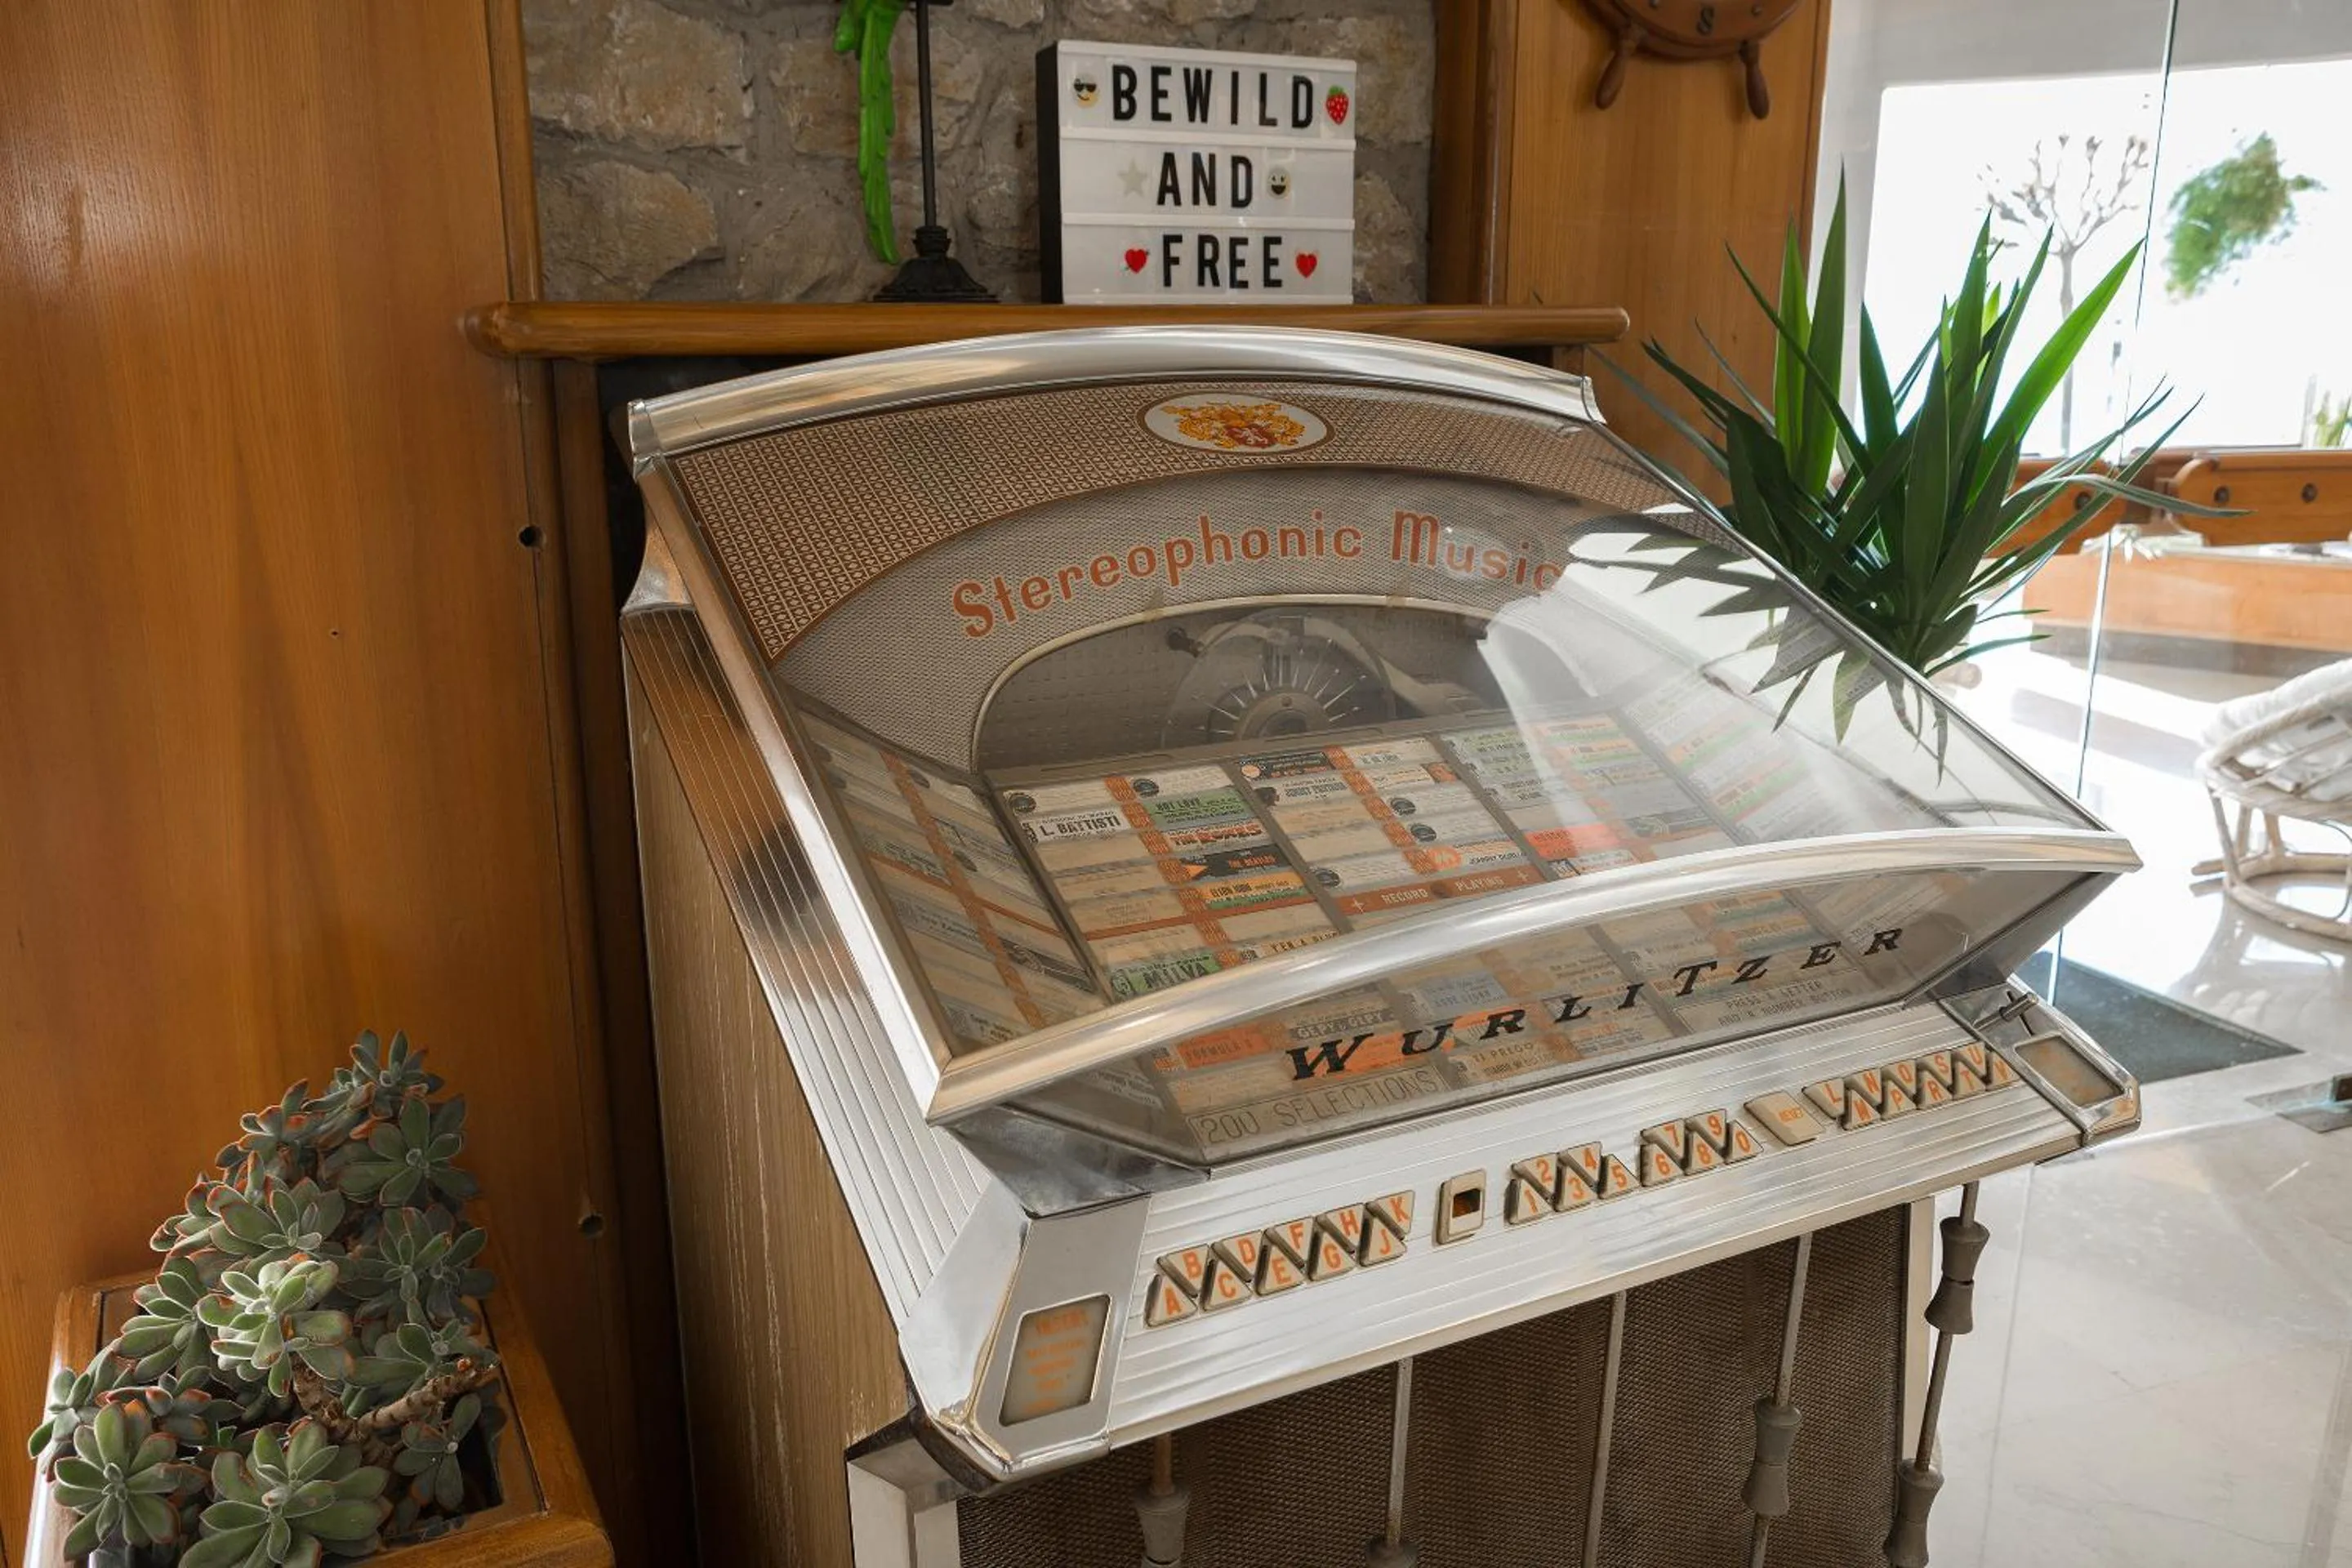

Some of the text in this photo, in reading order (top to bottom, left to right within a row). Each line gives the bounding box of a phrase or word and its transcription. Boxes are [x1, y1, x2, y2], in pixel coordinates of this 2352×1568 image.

[1111, 65, 1314, 128] BEWILD
[1156, 152, 1253, 207] AND
[1163, 234, 1283, 288] FREE
[951, 508, 1363, 640] Stereophonic
[1057, 815, 1121, 834] BATTISTI
[1455, 875, 1504, 893] PLAYING
[1286, 927, 1903, 1081] WURLITZER
[1934, 1054, 1949, 1074] S
[1967, 1046, 1983, 1066] U
[1824, 1083, 1842, 1103] L
[1863, 1071, 1879, 1093] N
[1890, 1089, 1903, 1111] P
[1927, 1080, 1943, 1100] R
[1960, 1071, 1975, 1091] T
[1199, 1069, 1439, 1145] 200 SELECTIONS
[1655, 1152, 1671, 1176] 6
[1664, 1125, 1680, 1147] 7
[1697, 1143, 1713, 1165] 8
[1708, 1112, 1722, 1136] 9
[1524, 1147, 1628, 1214] 1 2 3 4 5
[1164, 1196, 1410, 1316] A B C D E F G H J K
